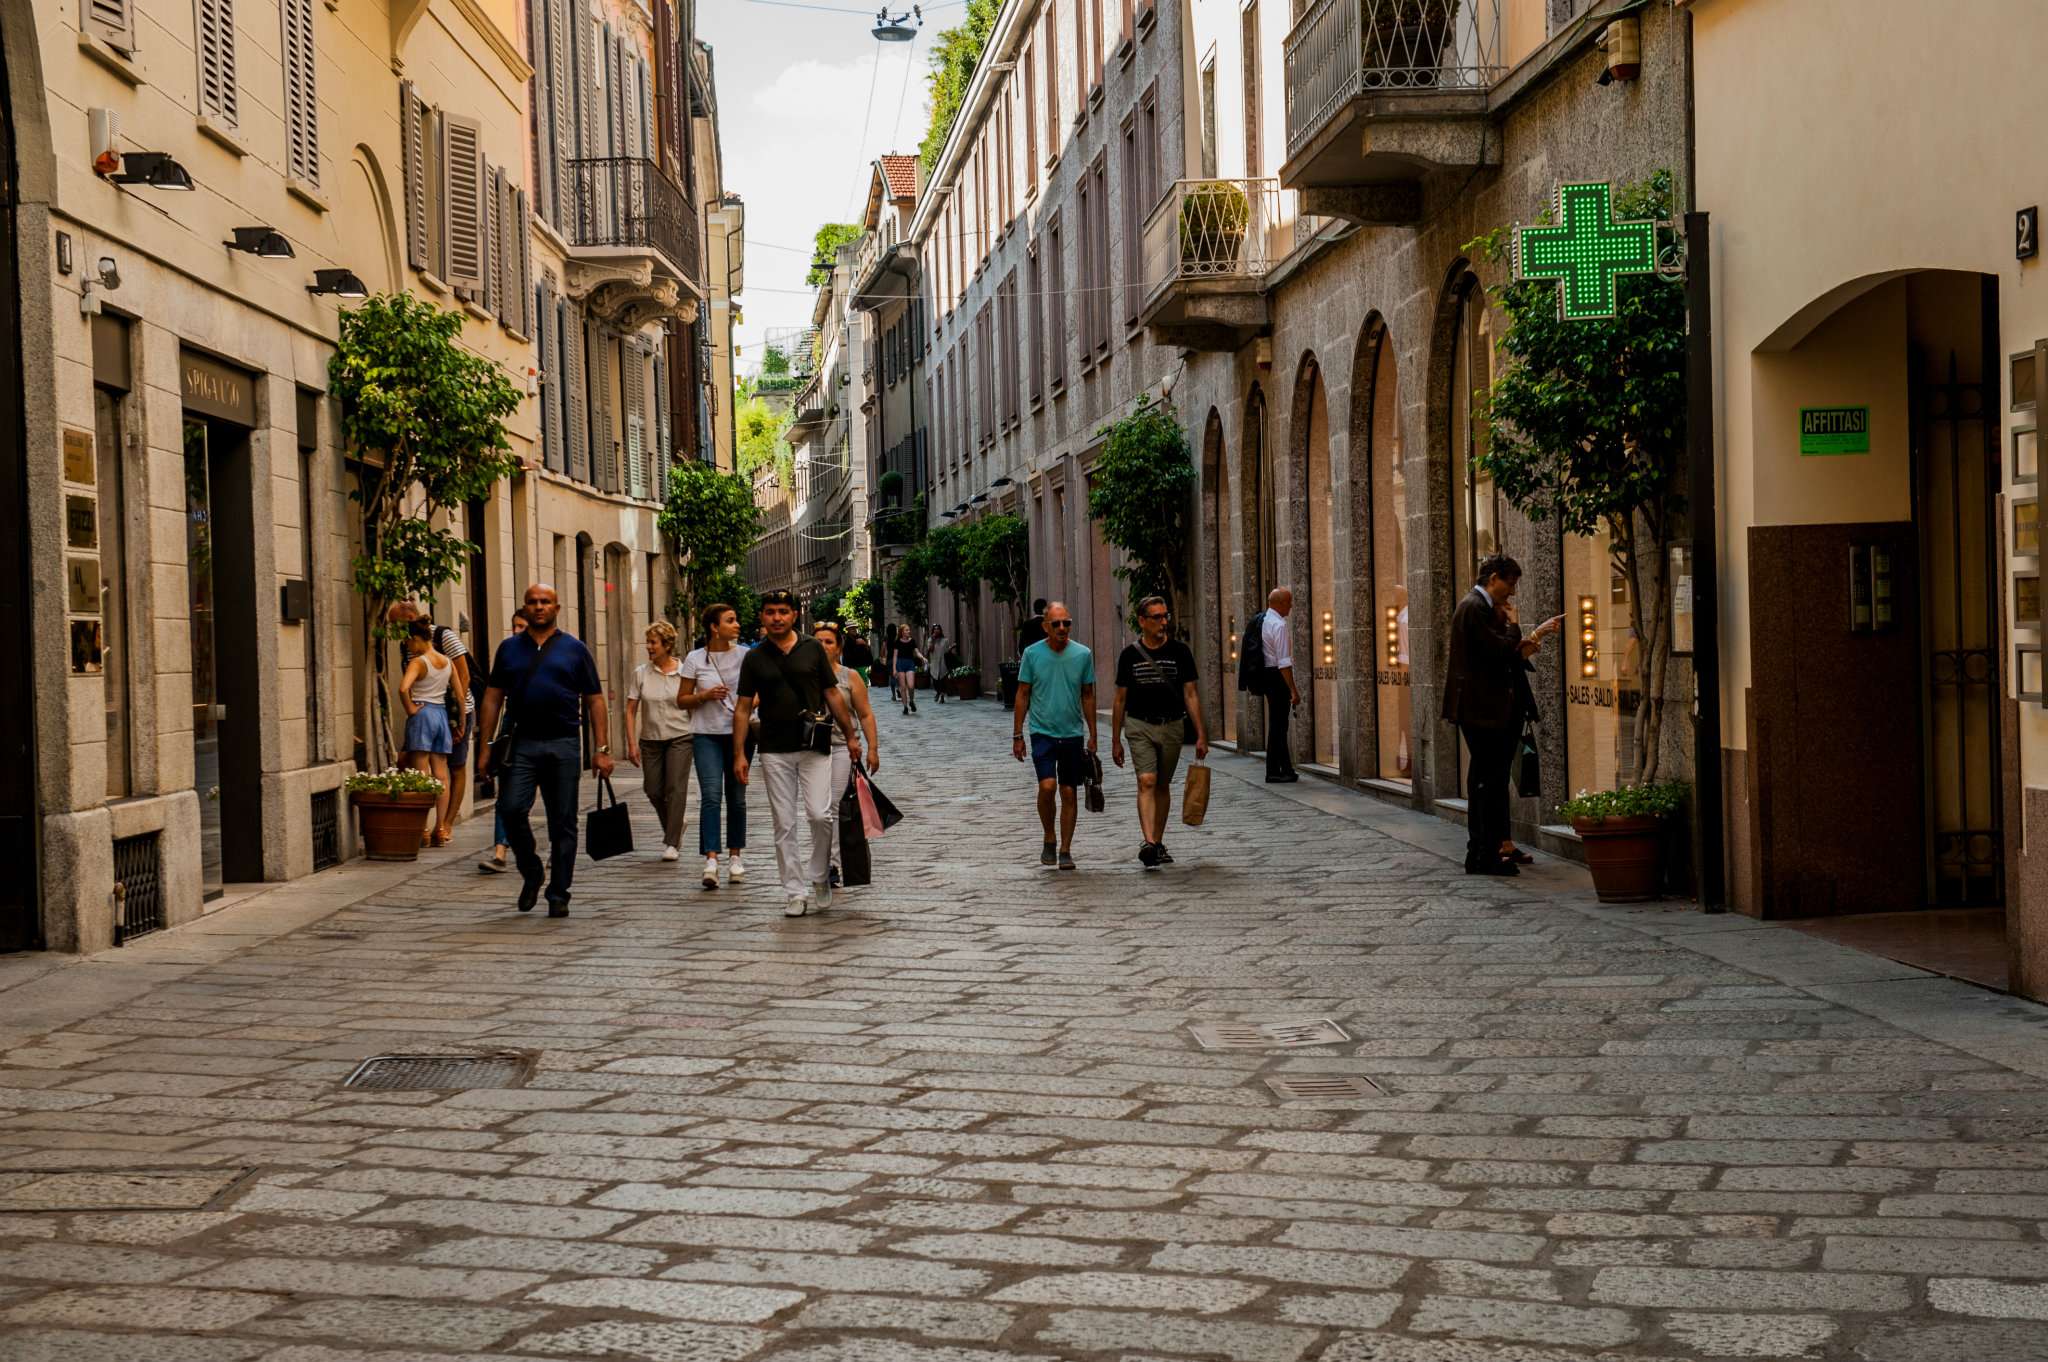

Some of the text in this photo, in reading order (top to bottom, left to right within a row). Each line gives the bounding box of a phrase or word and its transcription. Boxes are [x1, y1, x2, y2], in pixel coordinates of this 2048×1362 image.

[2018, 214, 2030, 250] 2
[186, 368, 218, 401] SPIGA
[1804, 410, 1865, 433] AFFITTASI
[1569, 685, 1590, 705] SALES
[1594, 687, 1614, 708] SALDI
